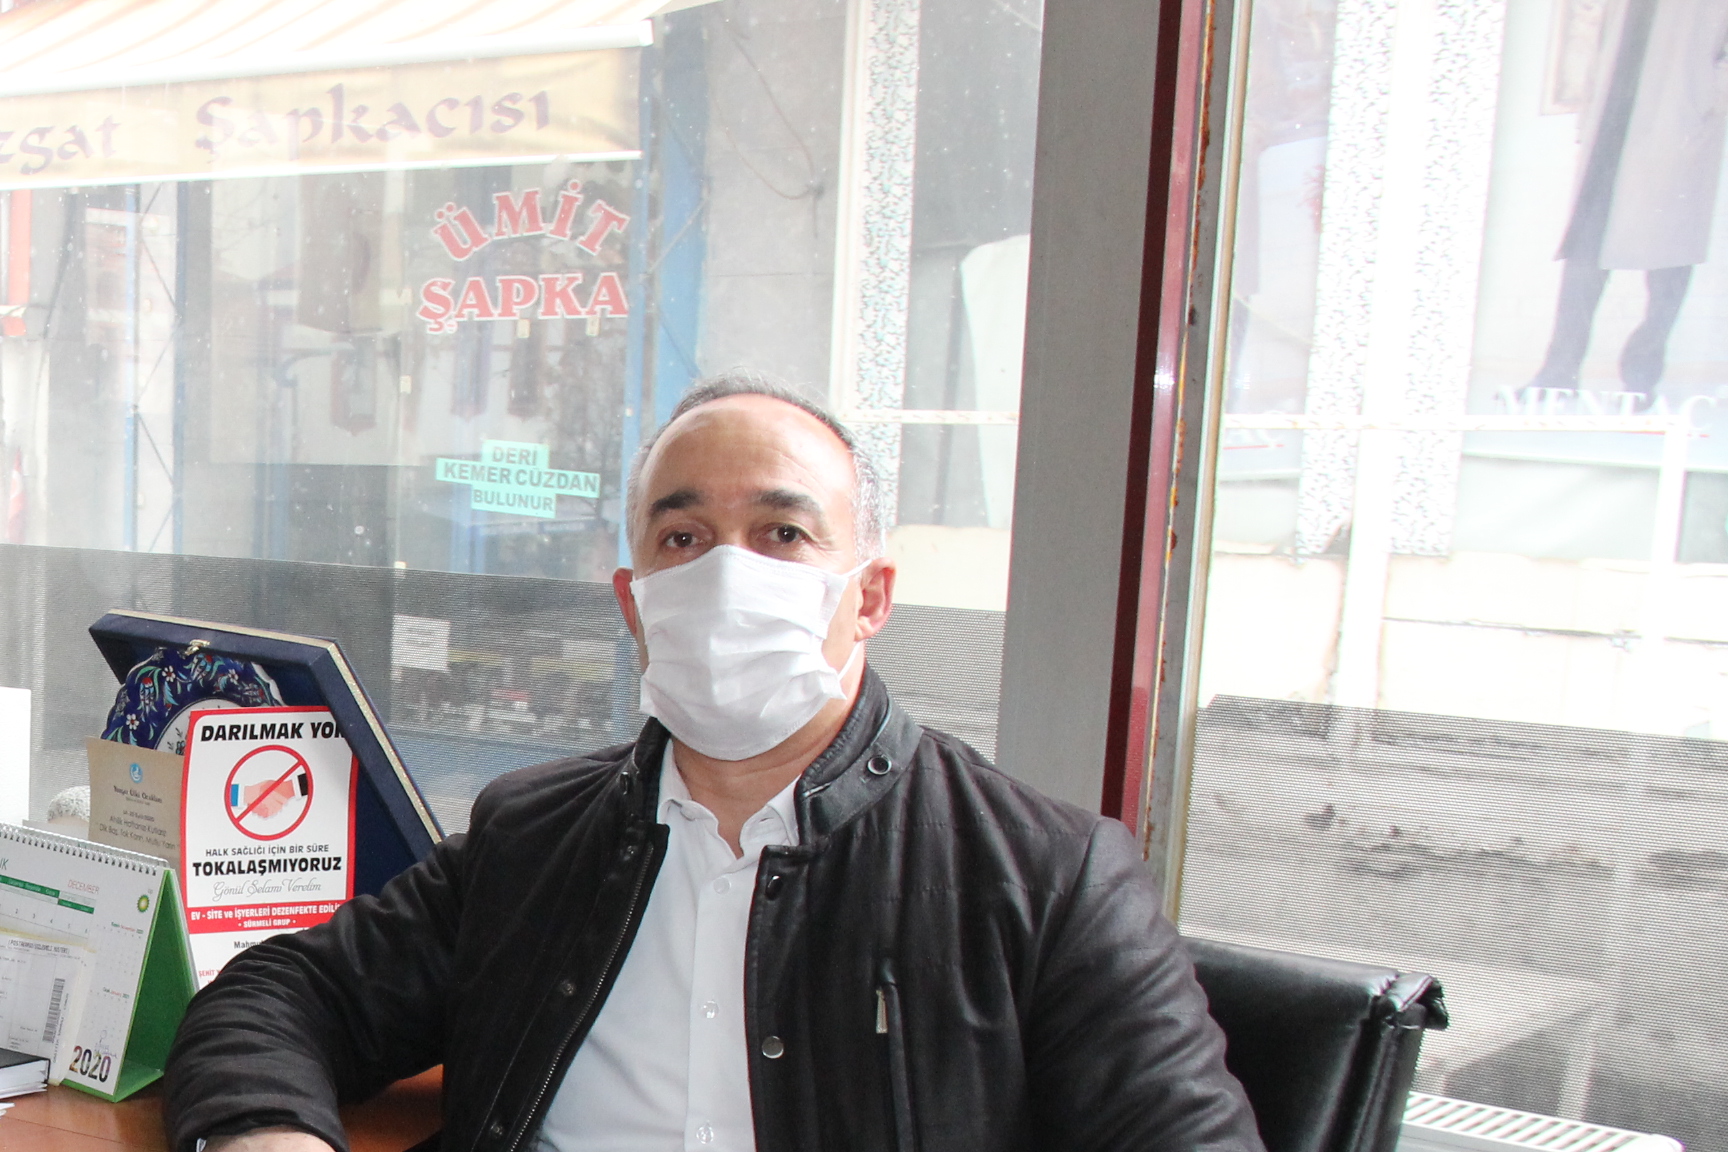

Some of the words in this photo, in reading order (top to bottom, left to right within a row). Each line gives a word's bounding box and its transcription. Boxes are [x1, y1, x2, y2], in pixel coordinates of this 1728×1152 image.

[194, 83, 551, 163] Şapkacısı
[431, 179, 632, 262] ÜMİT
[416, 271, 630, 334] ŞAPKA
[491, 445, 538, 467] DERİ
[443, 461, 512, 485] KEMER
[514, 466, 598, 493] CÜZDAN
[472, 488, 554, 512] BULUNUR
[200, 722, 304, 742] DARILMAK
[206, 848, 229, 857] HALK
[231, 844, 266, 856] SAĞLIĞI
[268, 844, 286, 856] İÇİN
[289, 843, 304, 853] BİR
[306, 842, 329, 852] SÜRE
[192, 857, 343, 877] TOKALAŞMIYORUZ
[67, 879, 101, 895] DECEMBER
[212, 880, 247, 902] Gönül
[282, 877, 322, 892] Verelim
[191, 912, 201, 921] EV
[207, 909, 223, 920] SİTE
[234, 906, 270, 920] İŞYERLERİ
[271, 905, 317, 917] DEZENFEKTE
[273, 918, 291, 927] GRUP
[234, 939, 263, 949] Mahmu
[69, 1045, 112, 1083] 2020
